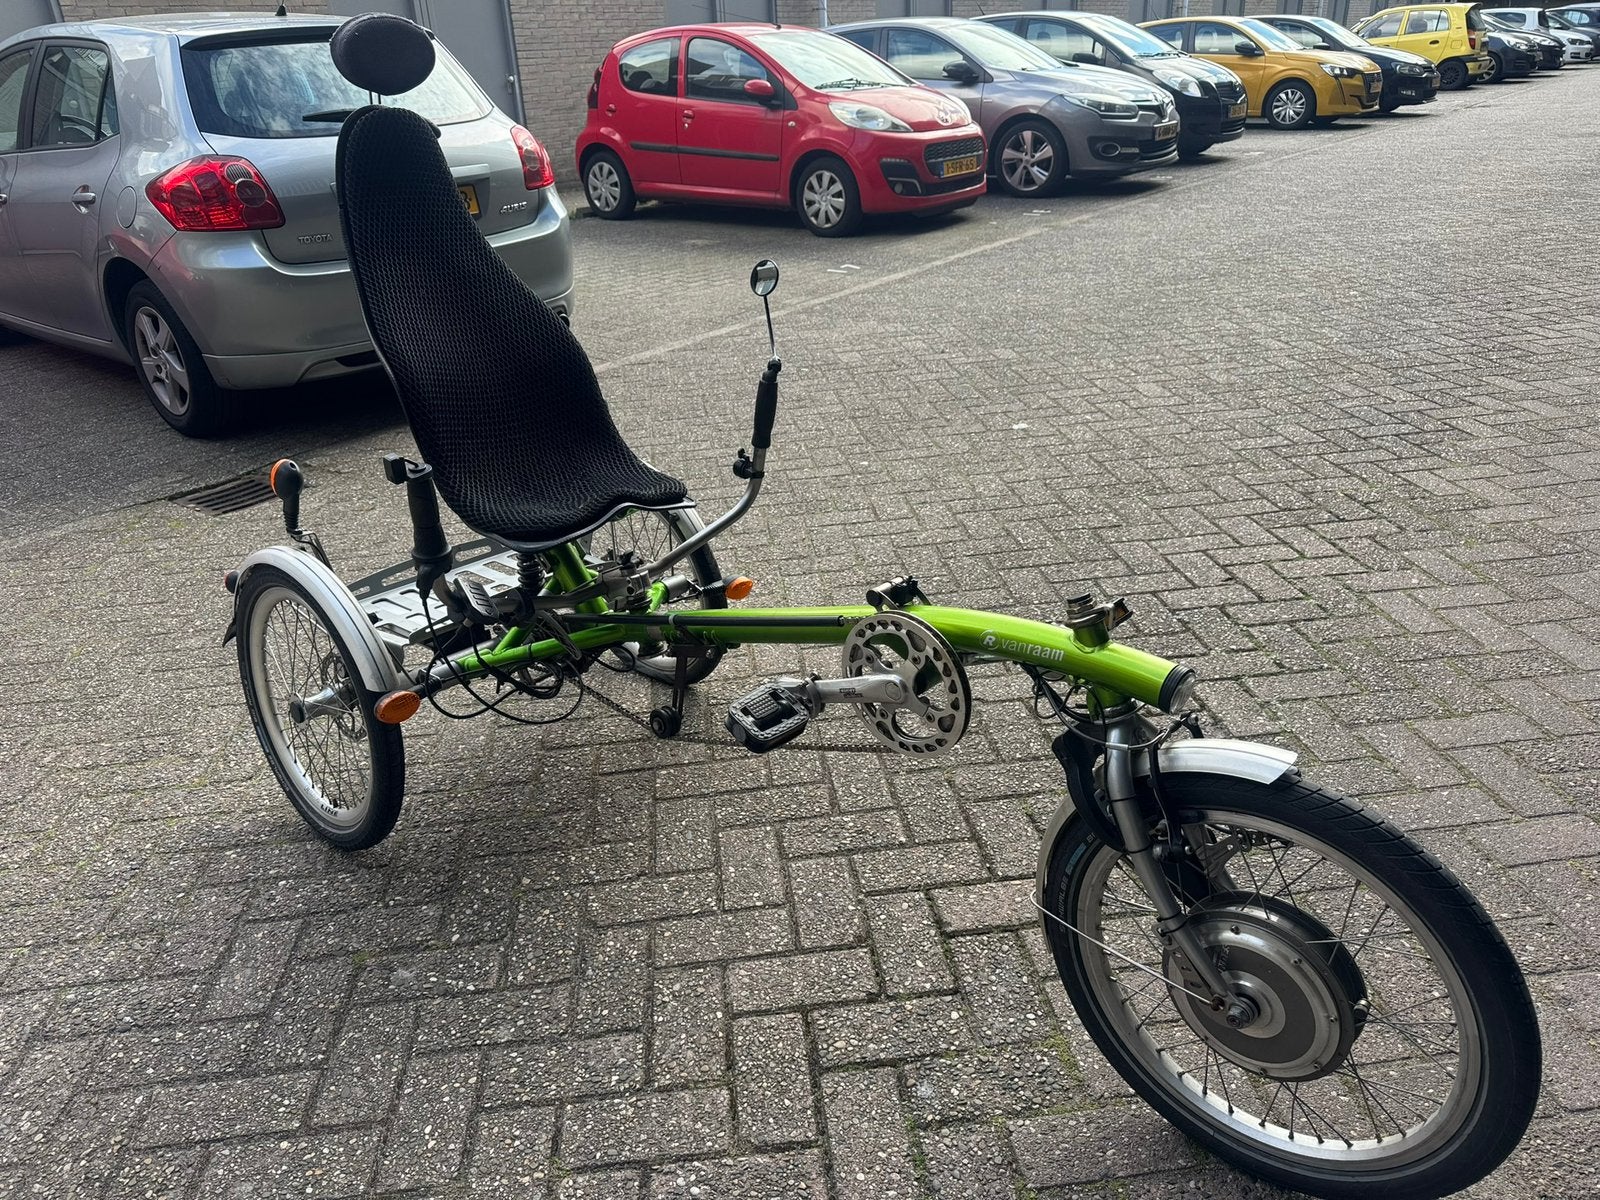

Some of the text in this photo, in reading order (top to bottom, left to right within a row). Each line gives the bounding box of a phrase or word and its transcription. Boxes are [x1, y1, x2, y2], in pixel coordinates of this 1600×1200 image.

[500, 201, 527, 213] AURIS
[298, 234, 333, 244] TOYOTA
[1001, 638, 1065, 661] vanraam
